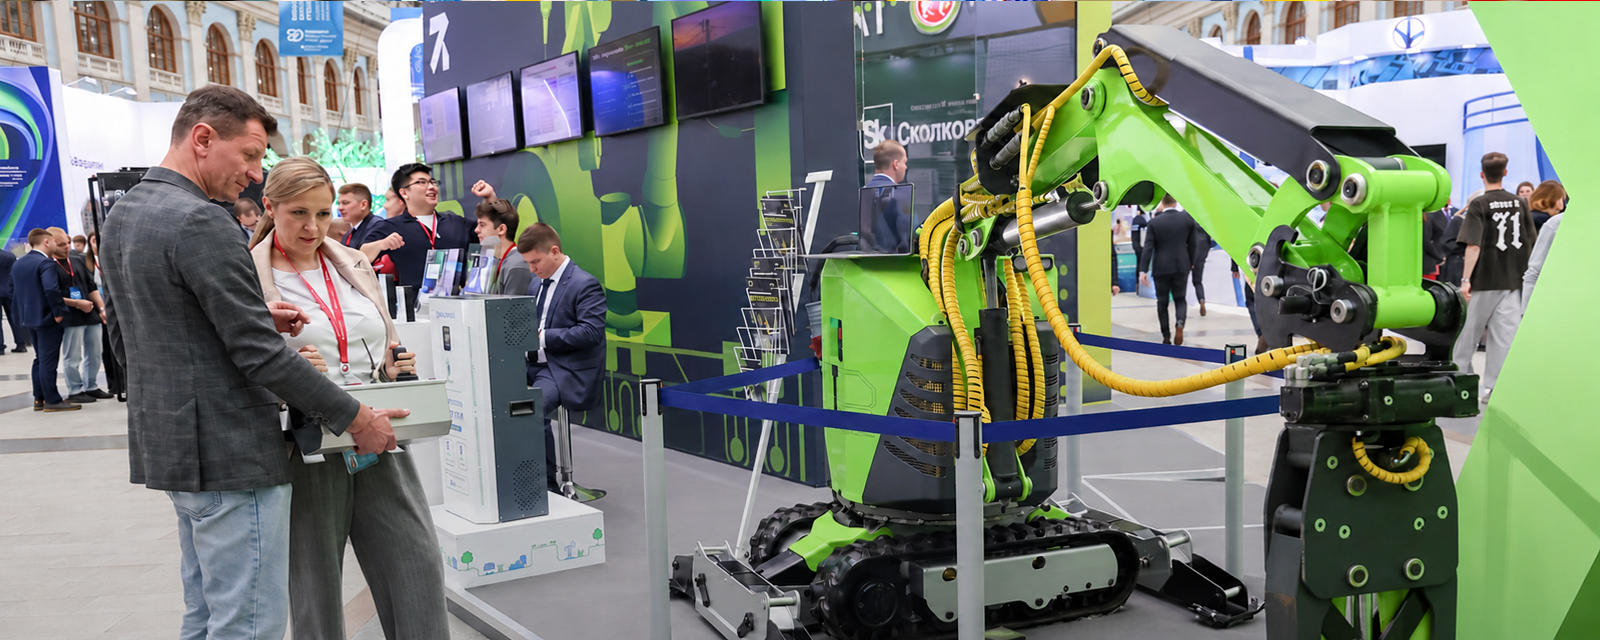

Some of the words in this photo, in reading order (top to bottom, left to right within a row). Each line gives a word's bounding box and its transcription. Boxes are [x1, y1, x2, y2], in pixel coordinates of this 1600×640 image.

[863, 118, 888, 150] Sk
[897, 116, 985, 147] Сколков
[1491, 211, 1523, 252] 71
